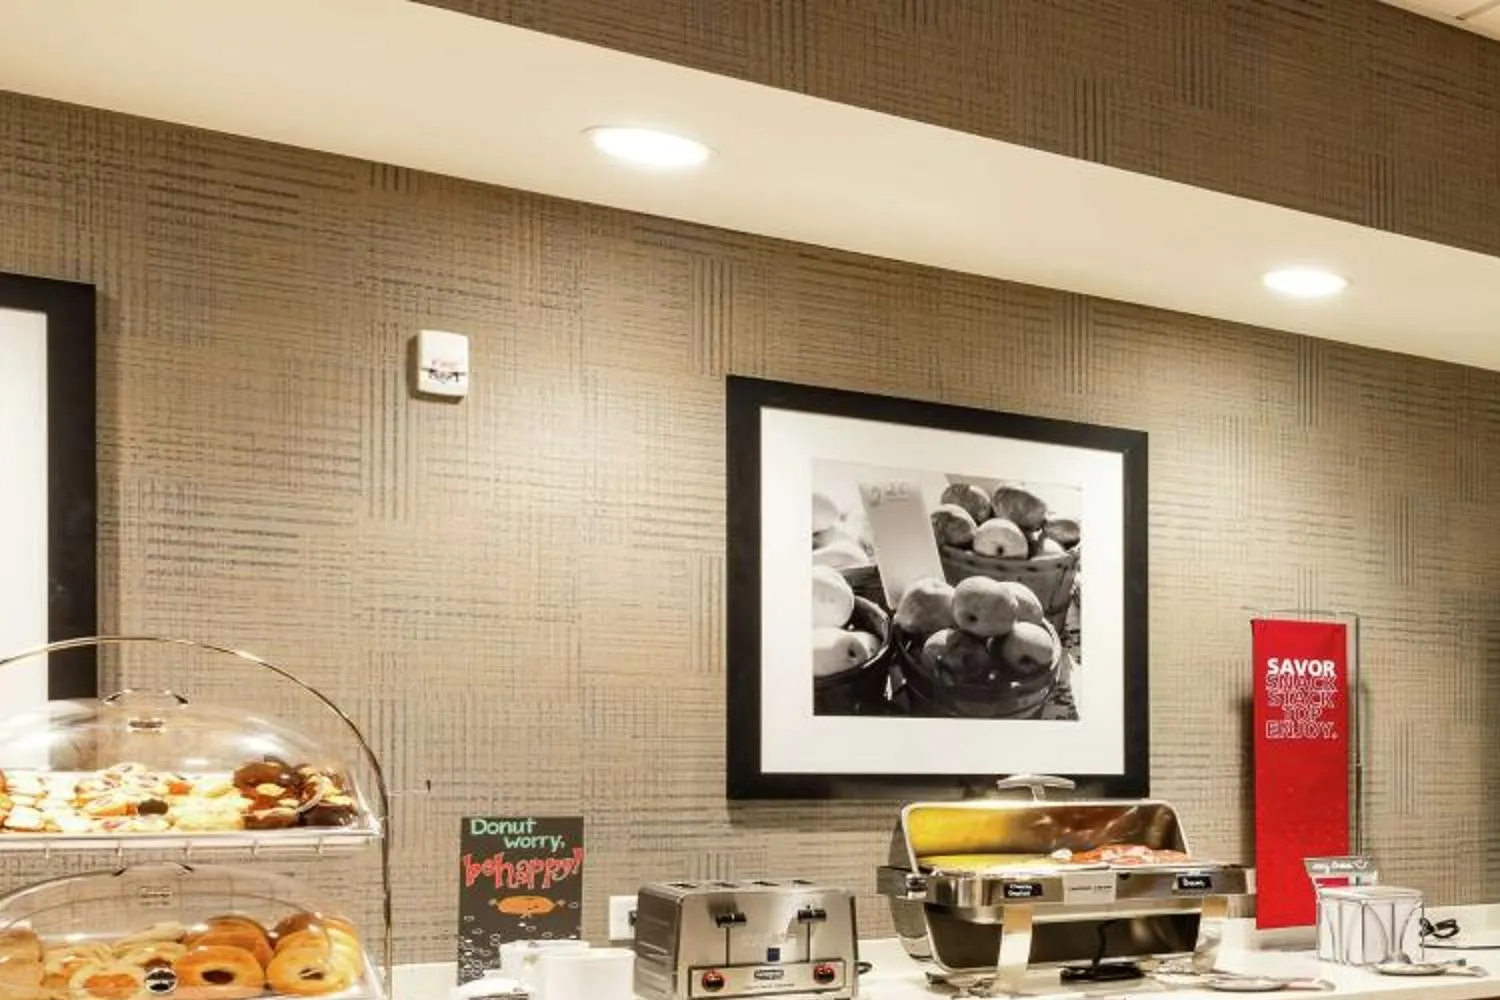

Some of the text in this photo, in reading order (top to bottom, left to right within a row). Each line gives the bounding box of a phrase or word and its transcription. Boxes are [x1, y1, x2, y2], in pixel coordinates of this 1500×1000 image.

[1267, 658, 1336, 677] SAVOR
[1265, 674, 1338, 692] SNACK
[1266, 690, 1336, 708] STACK
[1265, 720, 1339, 739] ENJOY.
[470, 818, 537, 835] Donut
